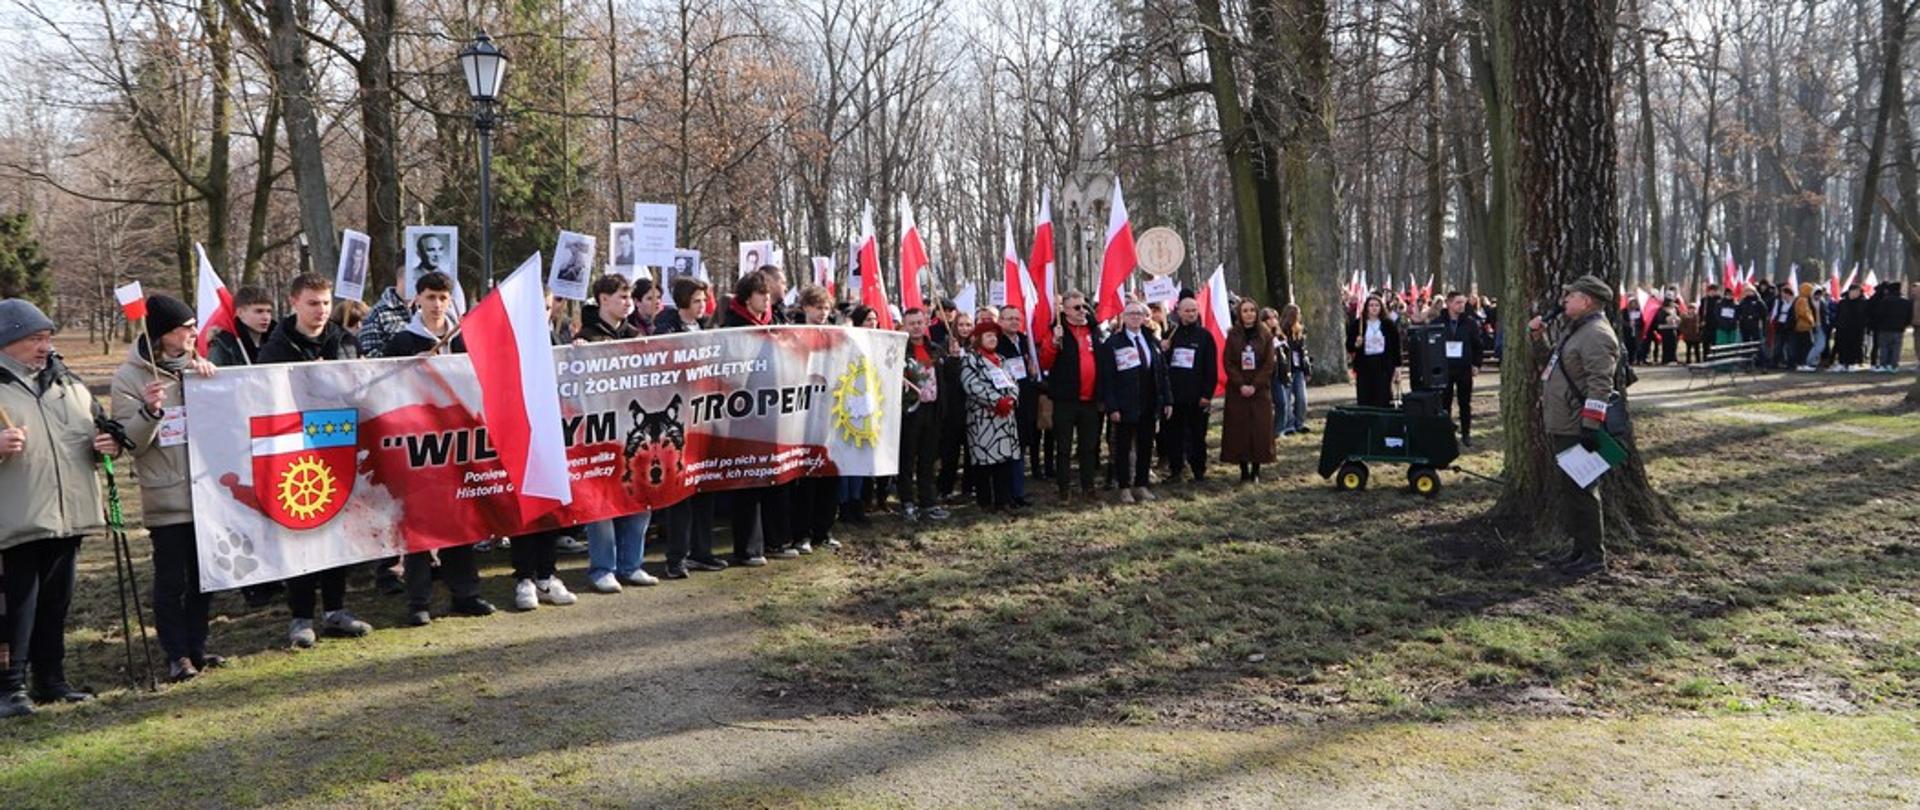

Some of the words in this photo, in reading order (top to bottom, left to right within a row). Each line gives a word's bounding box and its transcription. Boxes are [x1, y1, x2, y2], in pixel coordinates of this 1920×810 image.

[557, 351, 668, 376] POWIATOWY
[559, 382, 579, 397] CI
[585, 370, 681, 394] ŻOŁNIERZY
[735, 454, 757, 466] nich
[464, 468, 508, 483] Poniew
[455, 482, 504, 499] Historia
